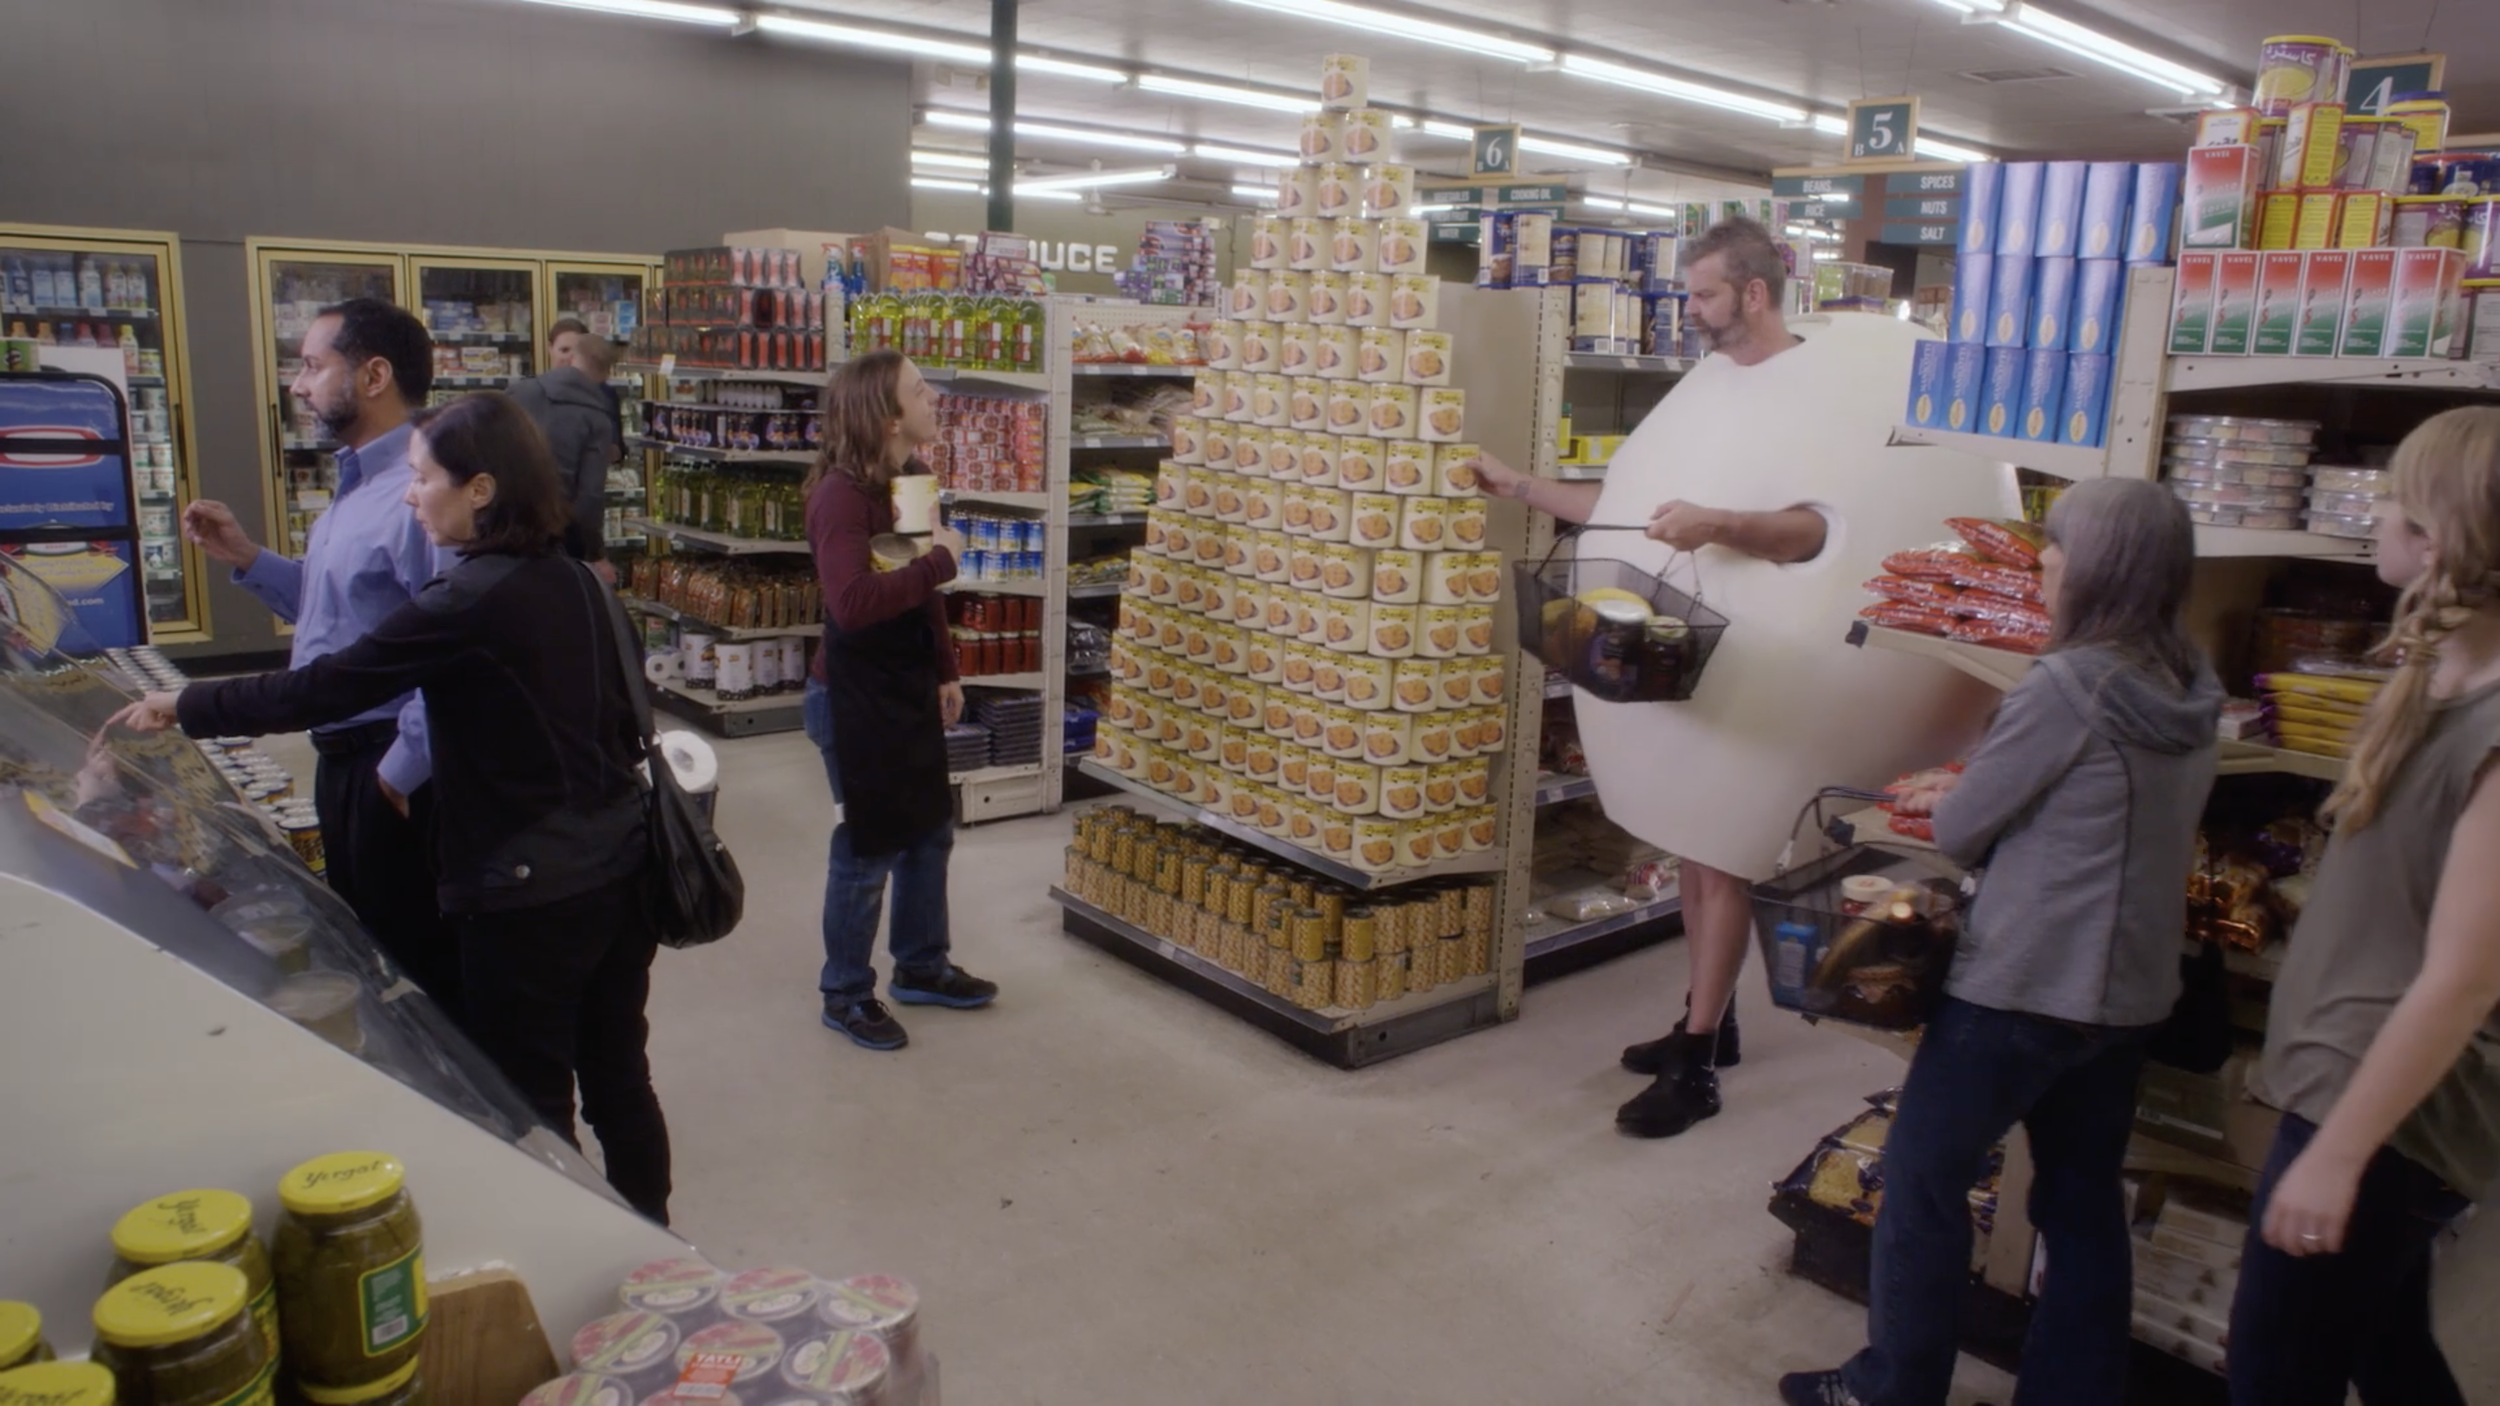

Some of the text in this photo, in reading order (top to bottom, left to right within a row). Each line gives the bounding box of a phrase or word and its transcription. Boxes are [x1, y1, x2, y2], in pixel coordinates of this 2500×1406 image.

[2359, 75, 2394, 118] 4
[1868, 111, 1894, 150] 5
[1485, 136, 1503, 168] 6
[1854, 143, 1865, 157] B
[1894, 141, 1906, 155] A
[1476, 161, 1484, 172] B
[1503, 160, 1511, 171] A
[1802, 179, 1833, 194] BEANS
[1919, 174, 1956, 190] SPICES
[1510, 188, 1552, 201] COOKING OIL
[1804, 203, 1826, 217] RICE
[1920, 200, 1949, 215] NUTS
[1919, 226, 1946, 241] SALT
